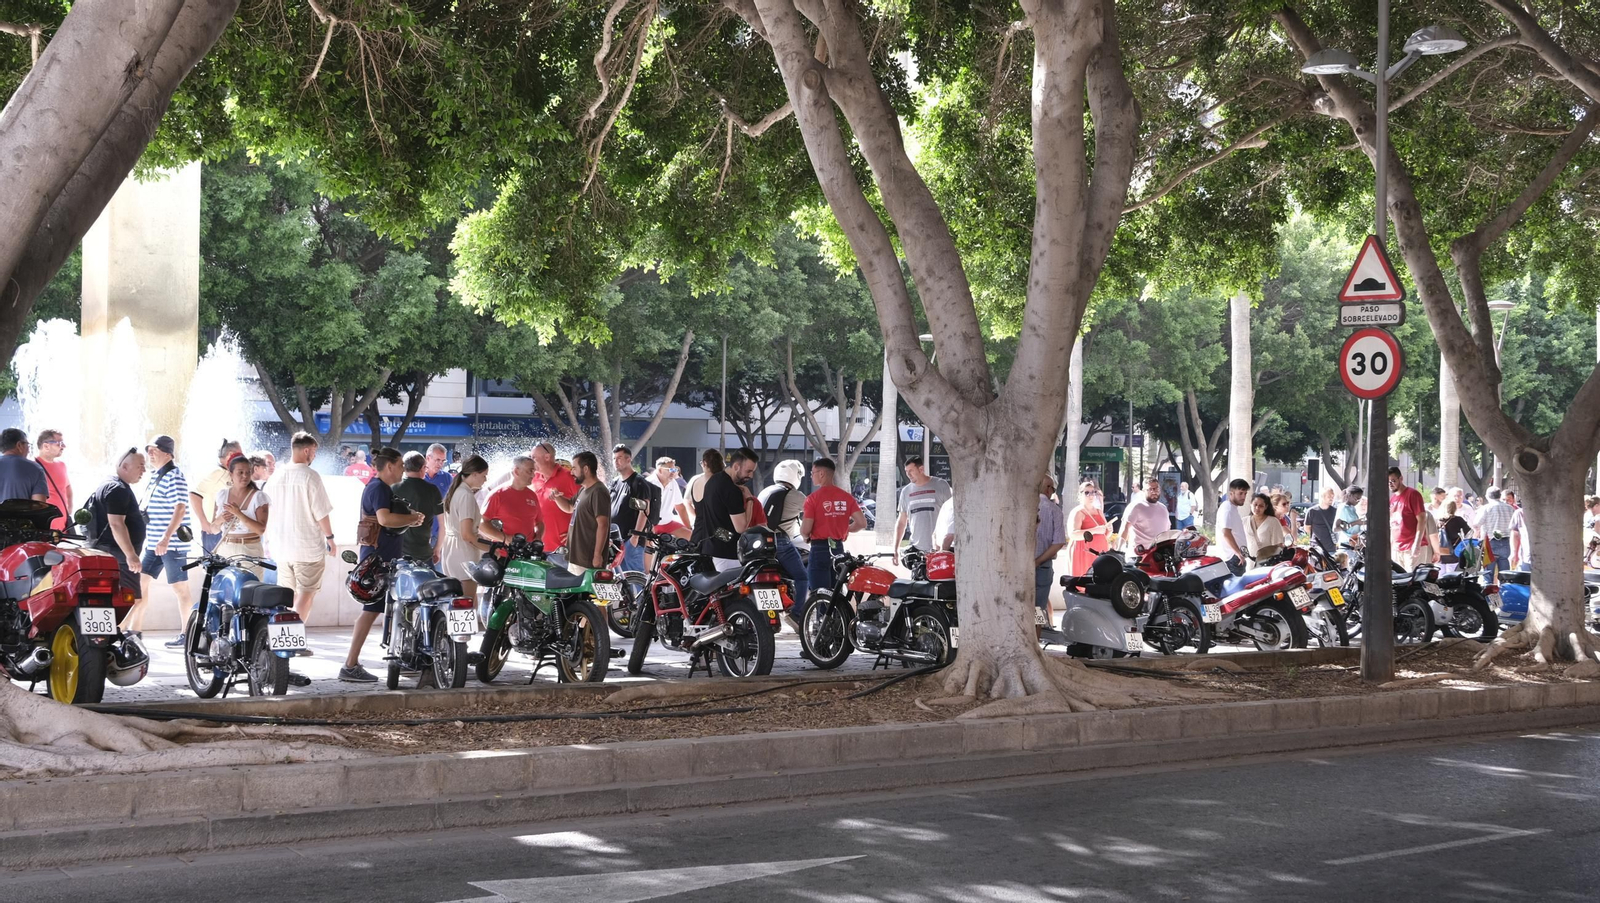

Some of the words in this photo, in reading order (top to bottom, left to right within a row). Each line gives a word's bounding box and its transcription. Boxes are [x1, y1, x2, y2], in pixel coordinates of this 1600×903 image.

[1342, 314, 1398, 322] SOBREELEVADO
[1351, 352, 1388, 376] 30
[771, 590, 776, 599] P
[761, 600, 779, 609] 2568
[87, 610, 94, 621] J
[103, 610, 112, 621] S
[85, 622, 113, 632] 3903
[281, 626, 294, 636] AL
[454, 622, 472, 632] 021
[272, 636, 305, 648] 25596
